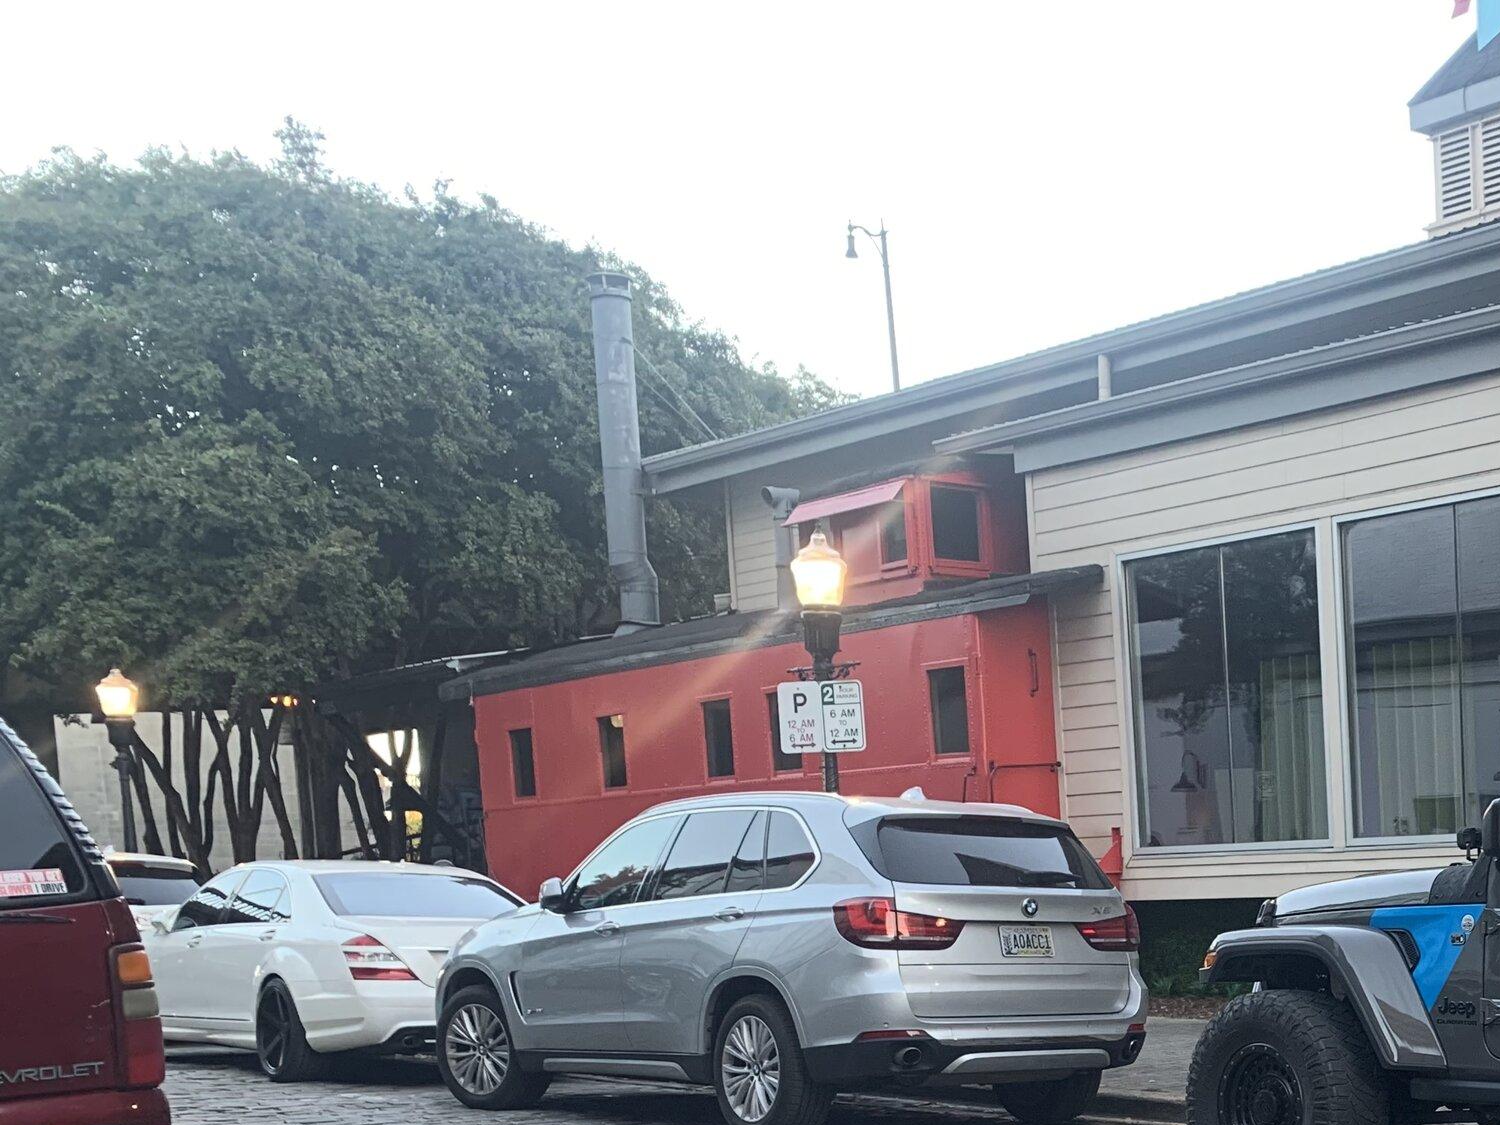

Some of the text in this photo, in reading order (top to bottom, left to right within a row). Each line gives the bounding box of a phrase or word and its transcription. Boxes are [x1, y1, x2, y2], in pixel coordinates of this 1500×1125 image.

[822, 686, 834, 702] 2
[793, 693, 808, 713] P
[830, 709, 855, 718] 6 AM
[787, 719, 815, 729] 12 AM
[789, 733, 814, 743] 6 AM
[830, 728, 859, 738] 12 AM
[41, 882, 66, 893] DRIVE
[1438, 996, 1476, 1019] Jeep
[0, 1061, 104, 1085] VROLET
